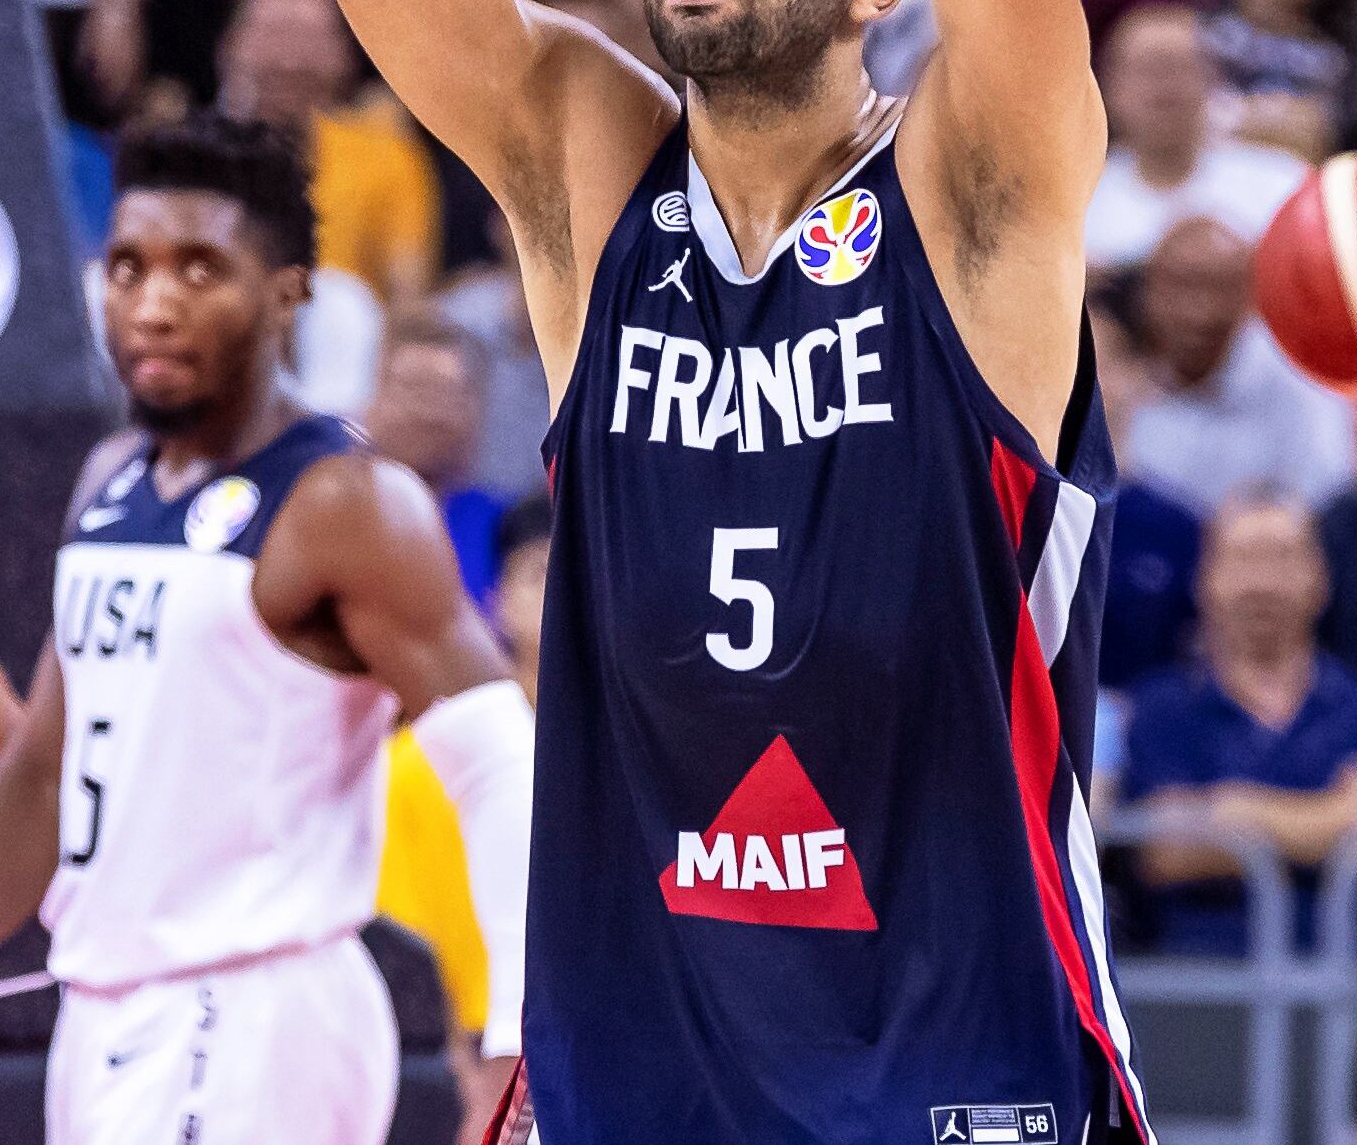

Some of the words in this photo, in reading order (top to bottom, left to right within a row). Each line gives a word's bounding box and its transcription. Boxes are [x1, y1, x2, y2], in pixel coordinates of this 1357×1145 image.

[609, 306, 894, 453] FRANCE
[59, 574, 167, 660] USA
[705, 528, 779, 672] 5
[63, 714, 113, 869] 5
[676, 828, 845, 891] MAIF
[1025, 1115, 1049, 1134] 56
